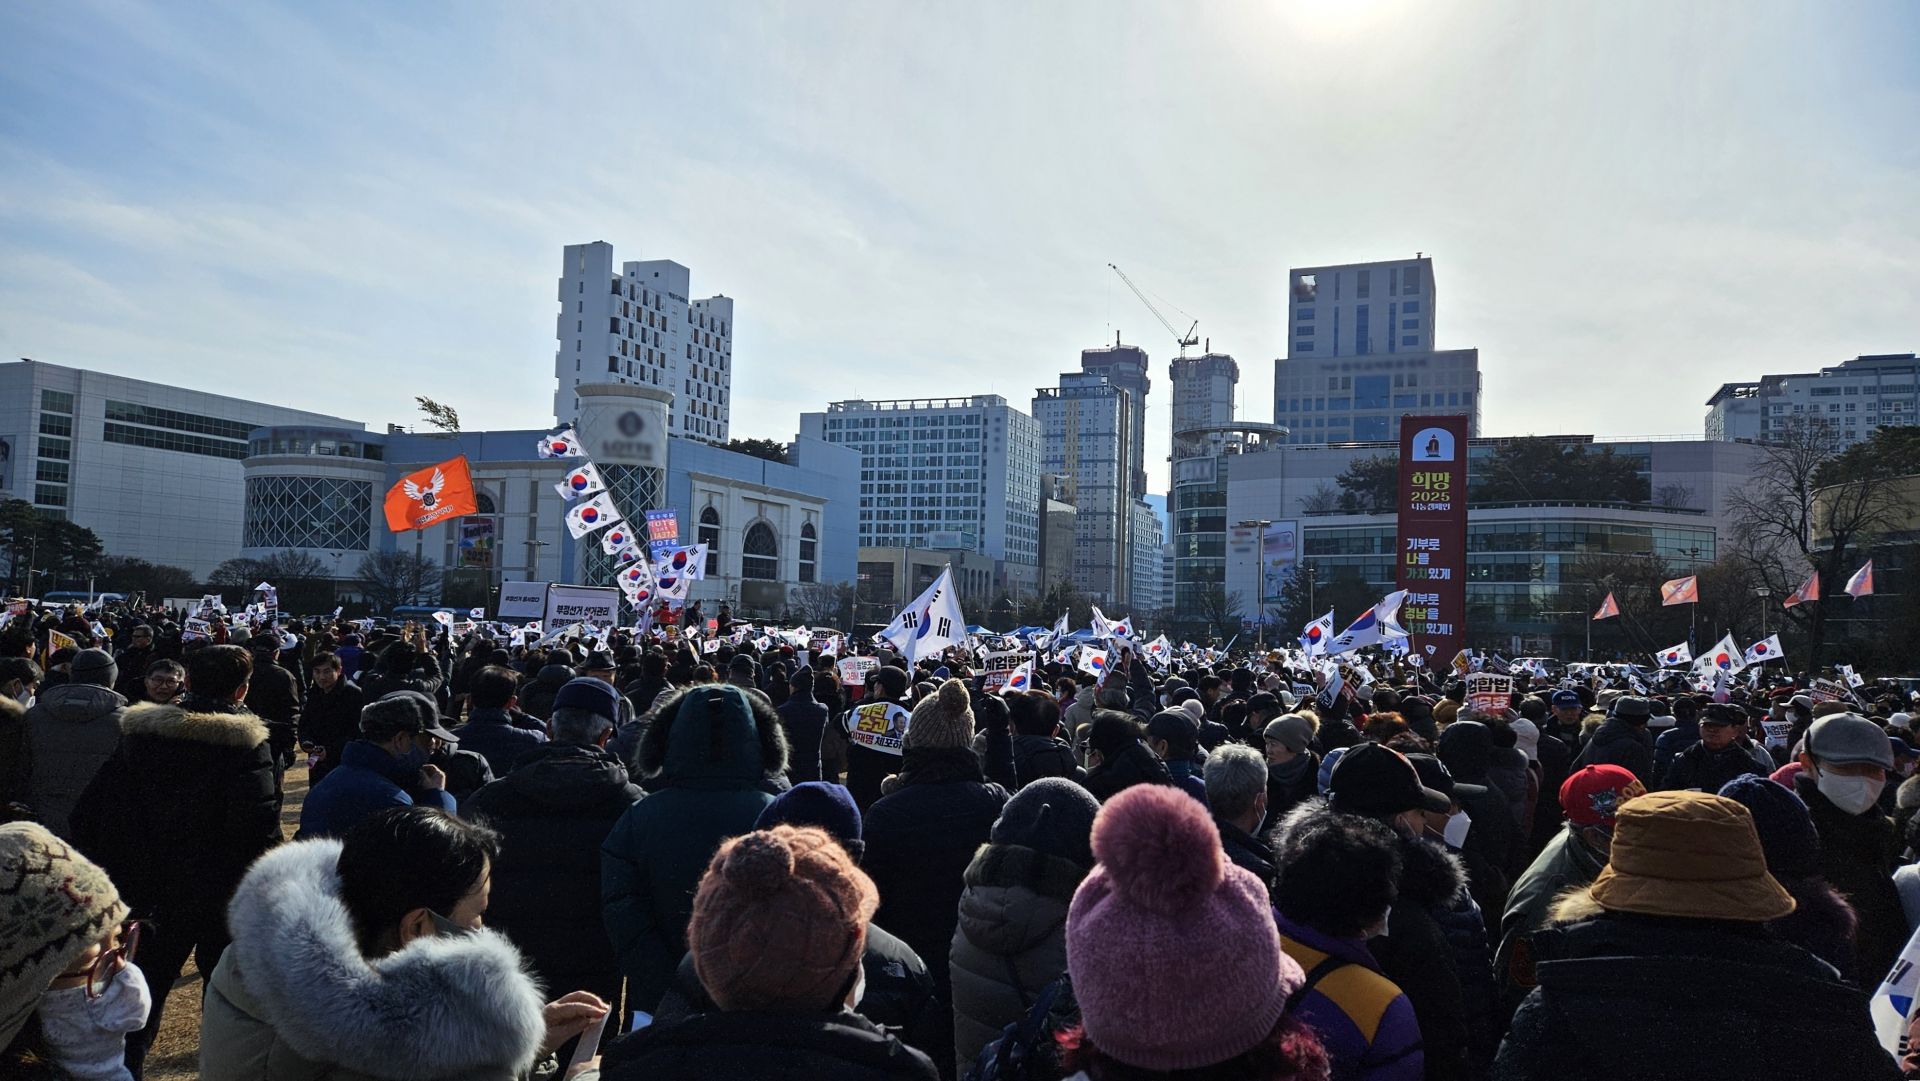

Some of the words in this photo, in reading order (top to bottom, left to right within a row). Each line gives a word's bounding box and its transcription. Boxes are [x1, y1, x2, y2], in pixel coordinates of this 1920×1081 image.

[1411, 471, 1451, 490] 희망
[1411, 491, 1450, 501] 2025
[1406, 538, 1440, 551] 기부로
[1405, 552, 1430, 565] 나를
[1407, 592, 1439, 605] 기부로
[556, 604, 583, 616] 부정선거
[584, 606, 610, 617] 선거관리
[1405, 607, 1439, 620] 경남을
[857, 718, 889, 736] 수괴
[851, 731, 875, 745] 이재명
[875, 736, 903, 749] 체포하
